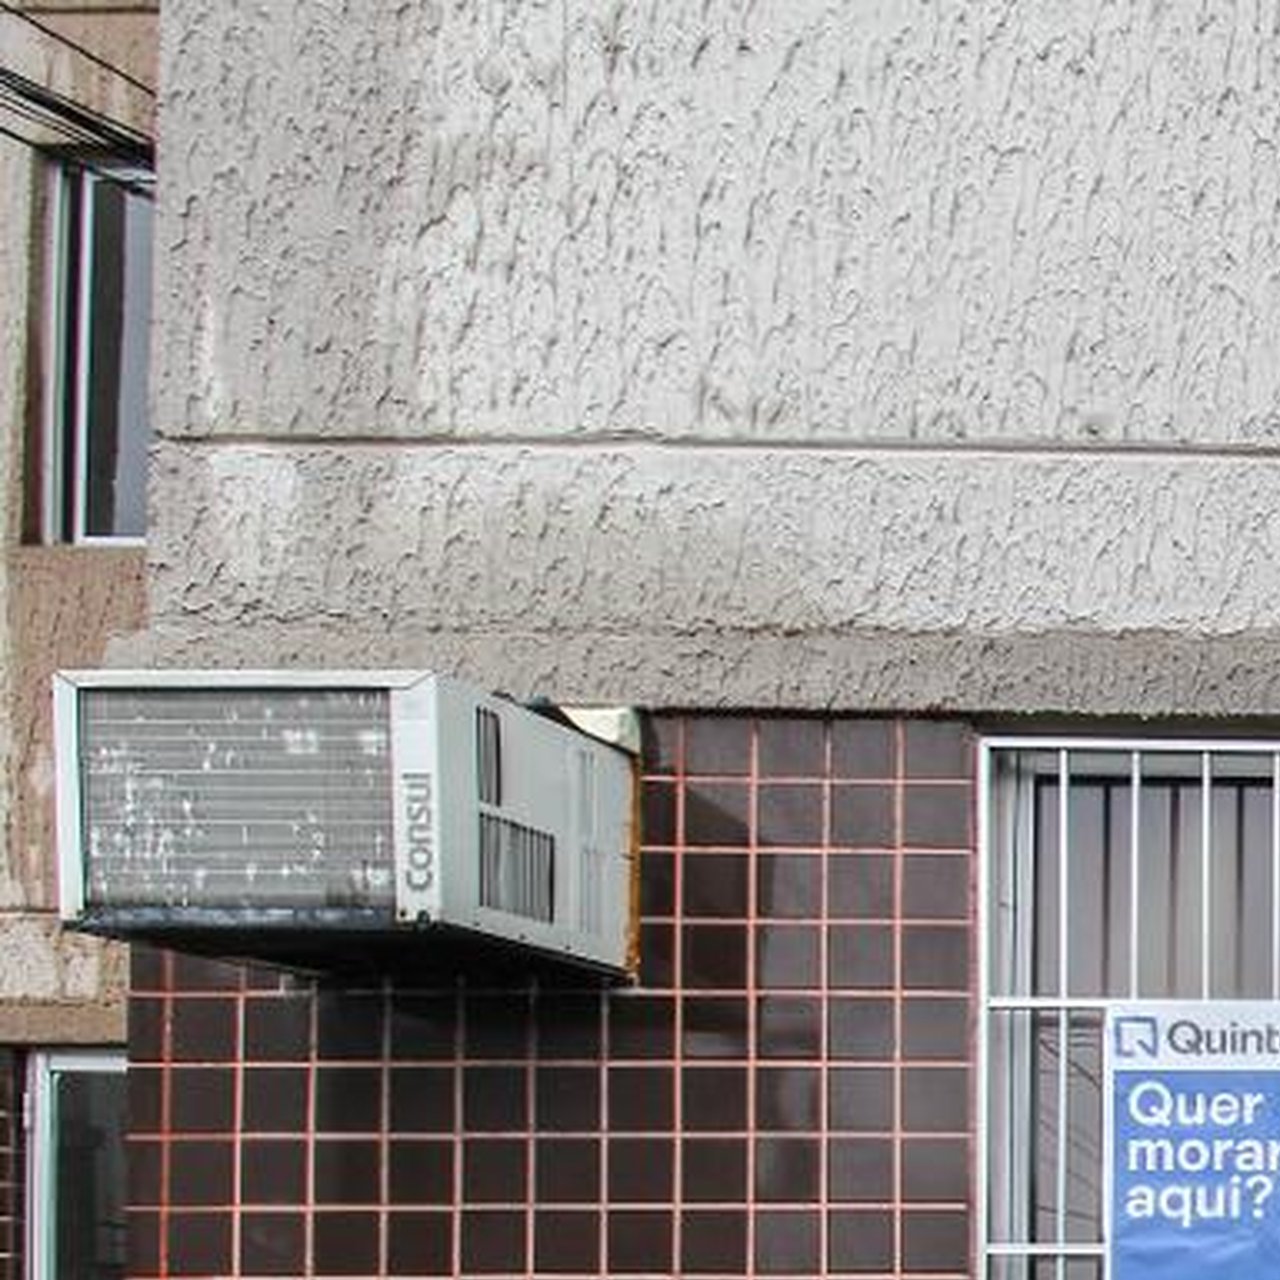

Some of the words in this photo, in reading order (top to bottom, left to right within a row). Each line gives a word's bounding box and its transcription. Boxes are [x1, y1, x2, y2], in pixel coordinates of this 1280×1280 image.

[402, 773, 432, 892] consul
[1127, 1082, 1265, 1126] Quer
[1126, 1175, 1274, 1227] aqui?
